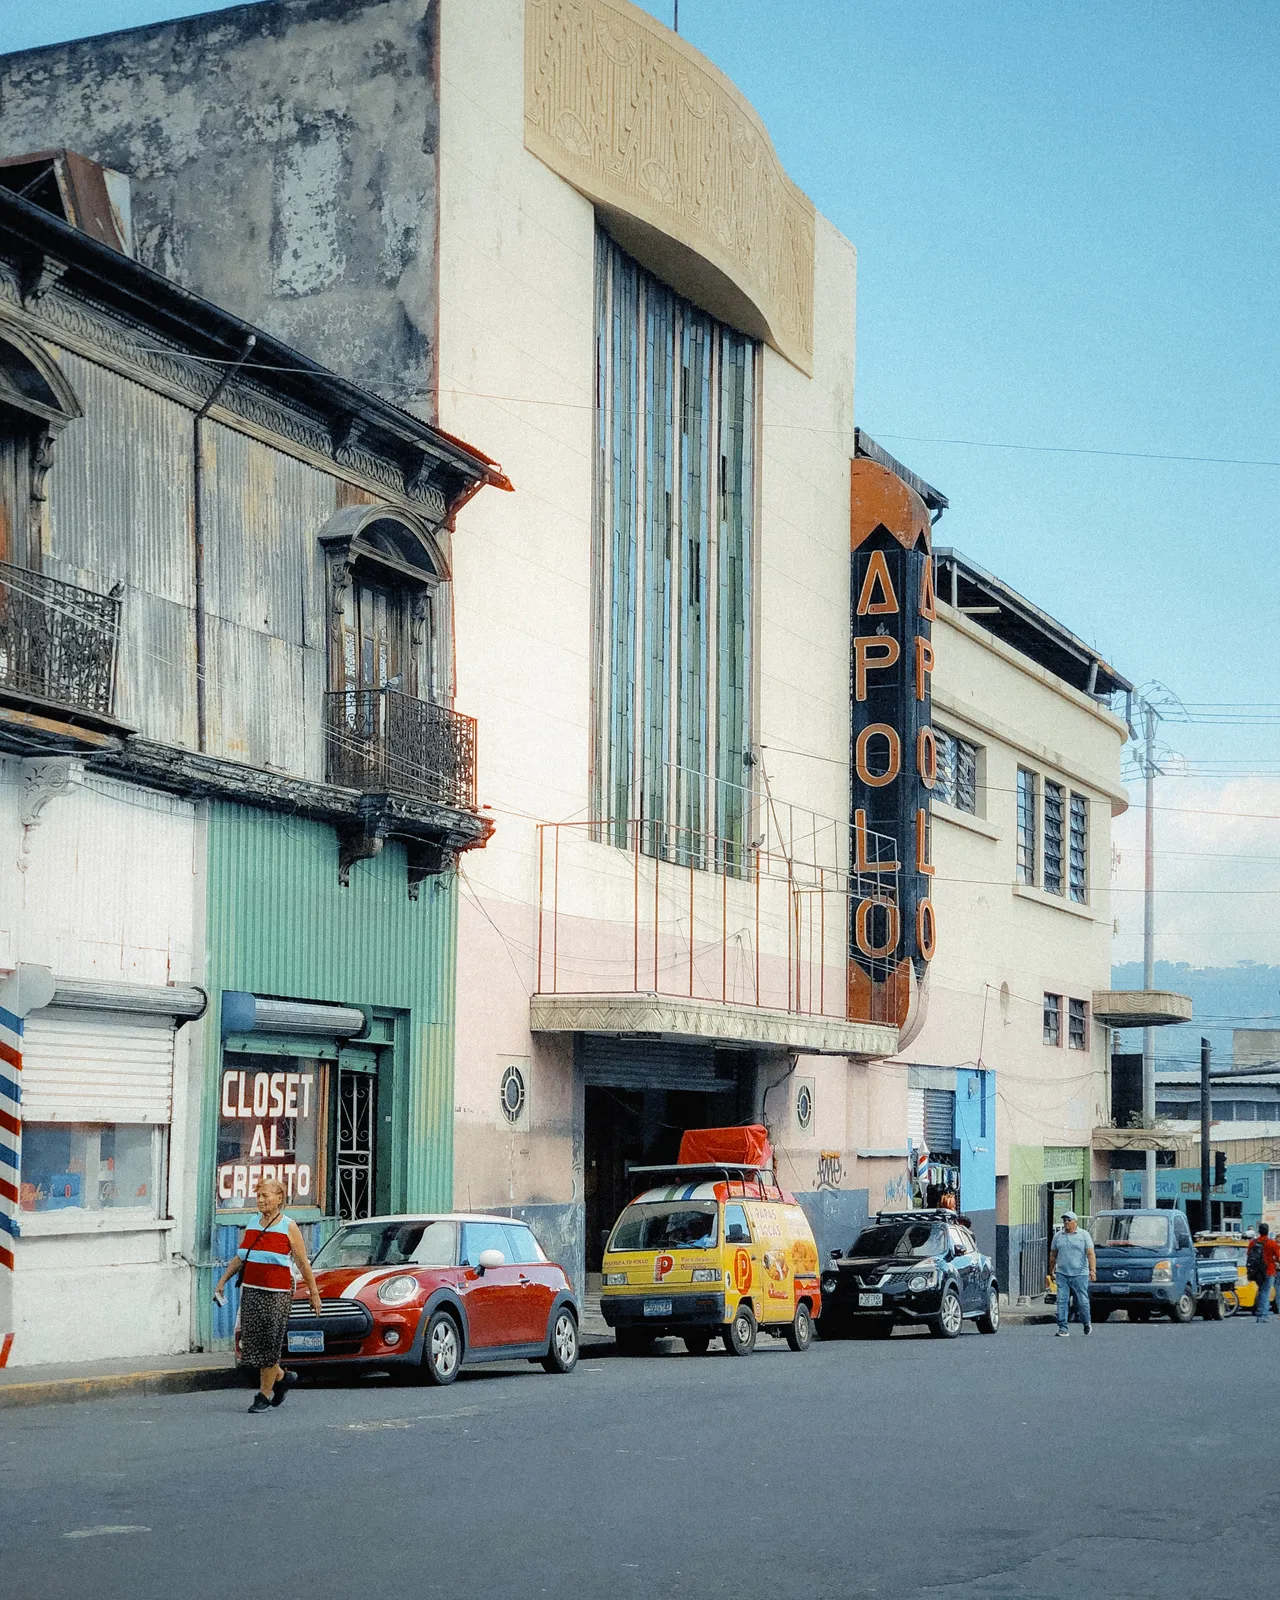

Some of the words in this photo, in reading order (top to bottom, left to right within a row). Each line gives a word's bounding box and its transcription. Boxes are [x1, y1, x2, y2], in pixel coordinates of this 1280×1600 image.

[854, 550, 902, 960] APOLO
[914, 553, 937, 963] APOLO
[221, 1070, 314, 1118] CLOSET
[248, 1124, 286, 1158] AL
[1130, 1181, 1176, 1193] VIERIA
[1180, 1182, 1227, 1194] EMAUEL
[754, 1207, 777, 1220] PAPAS
